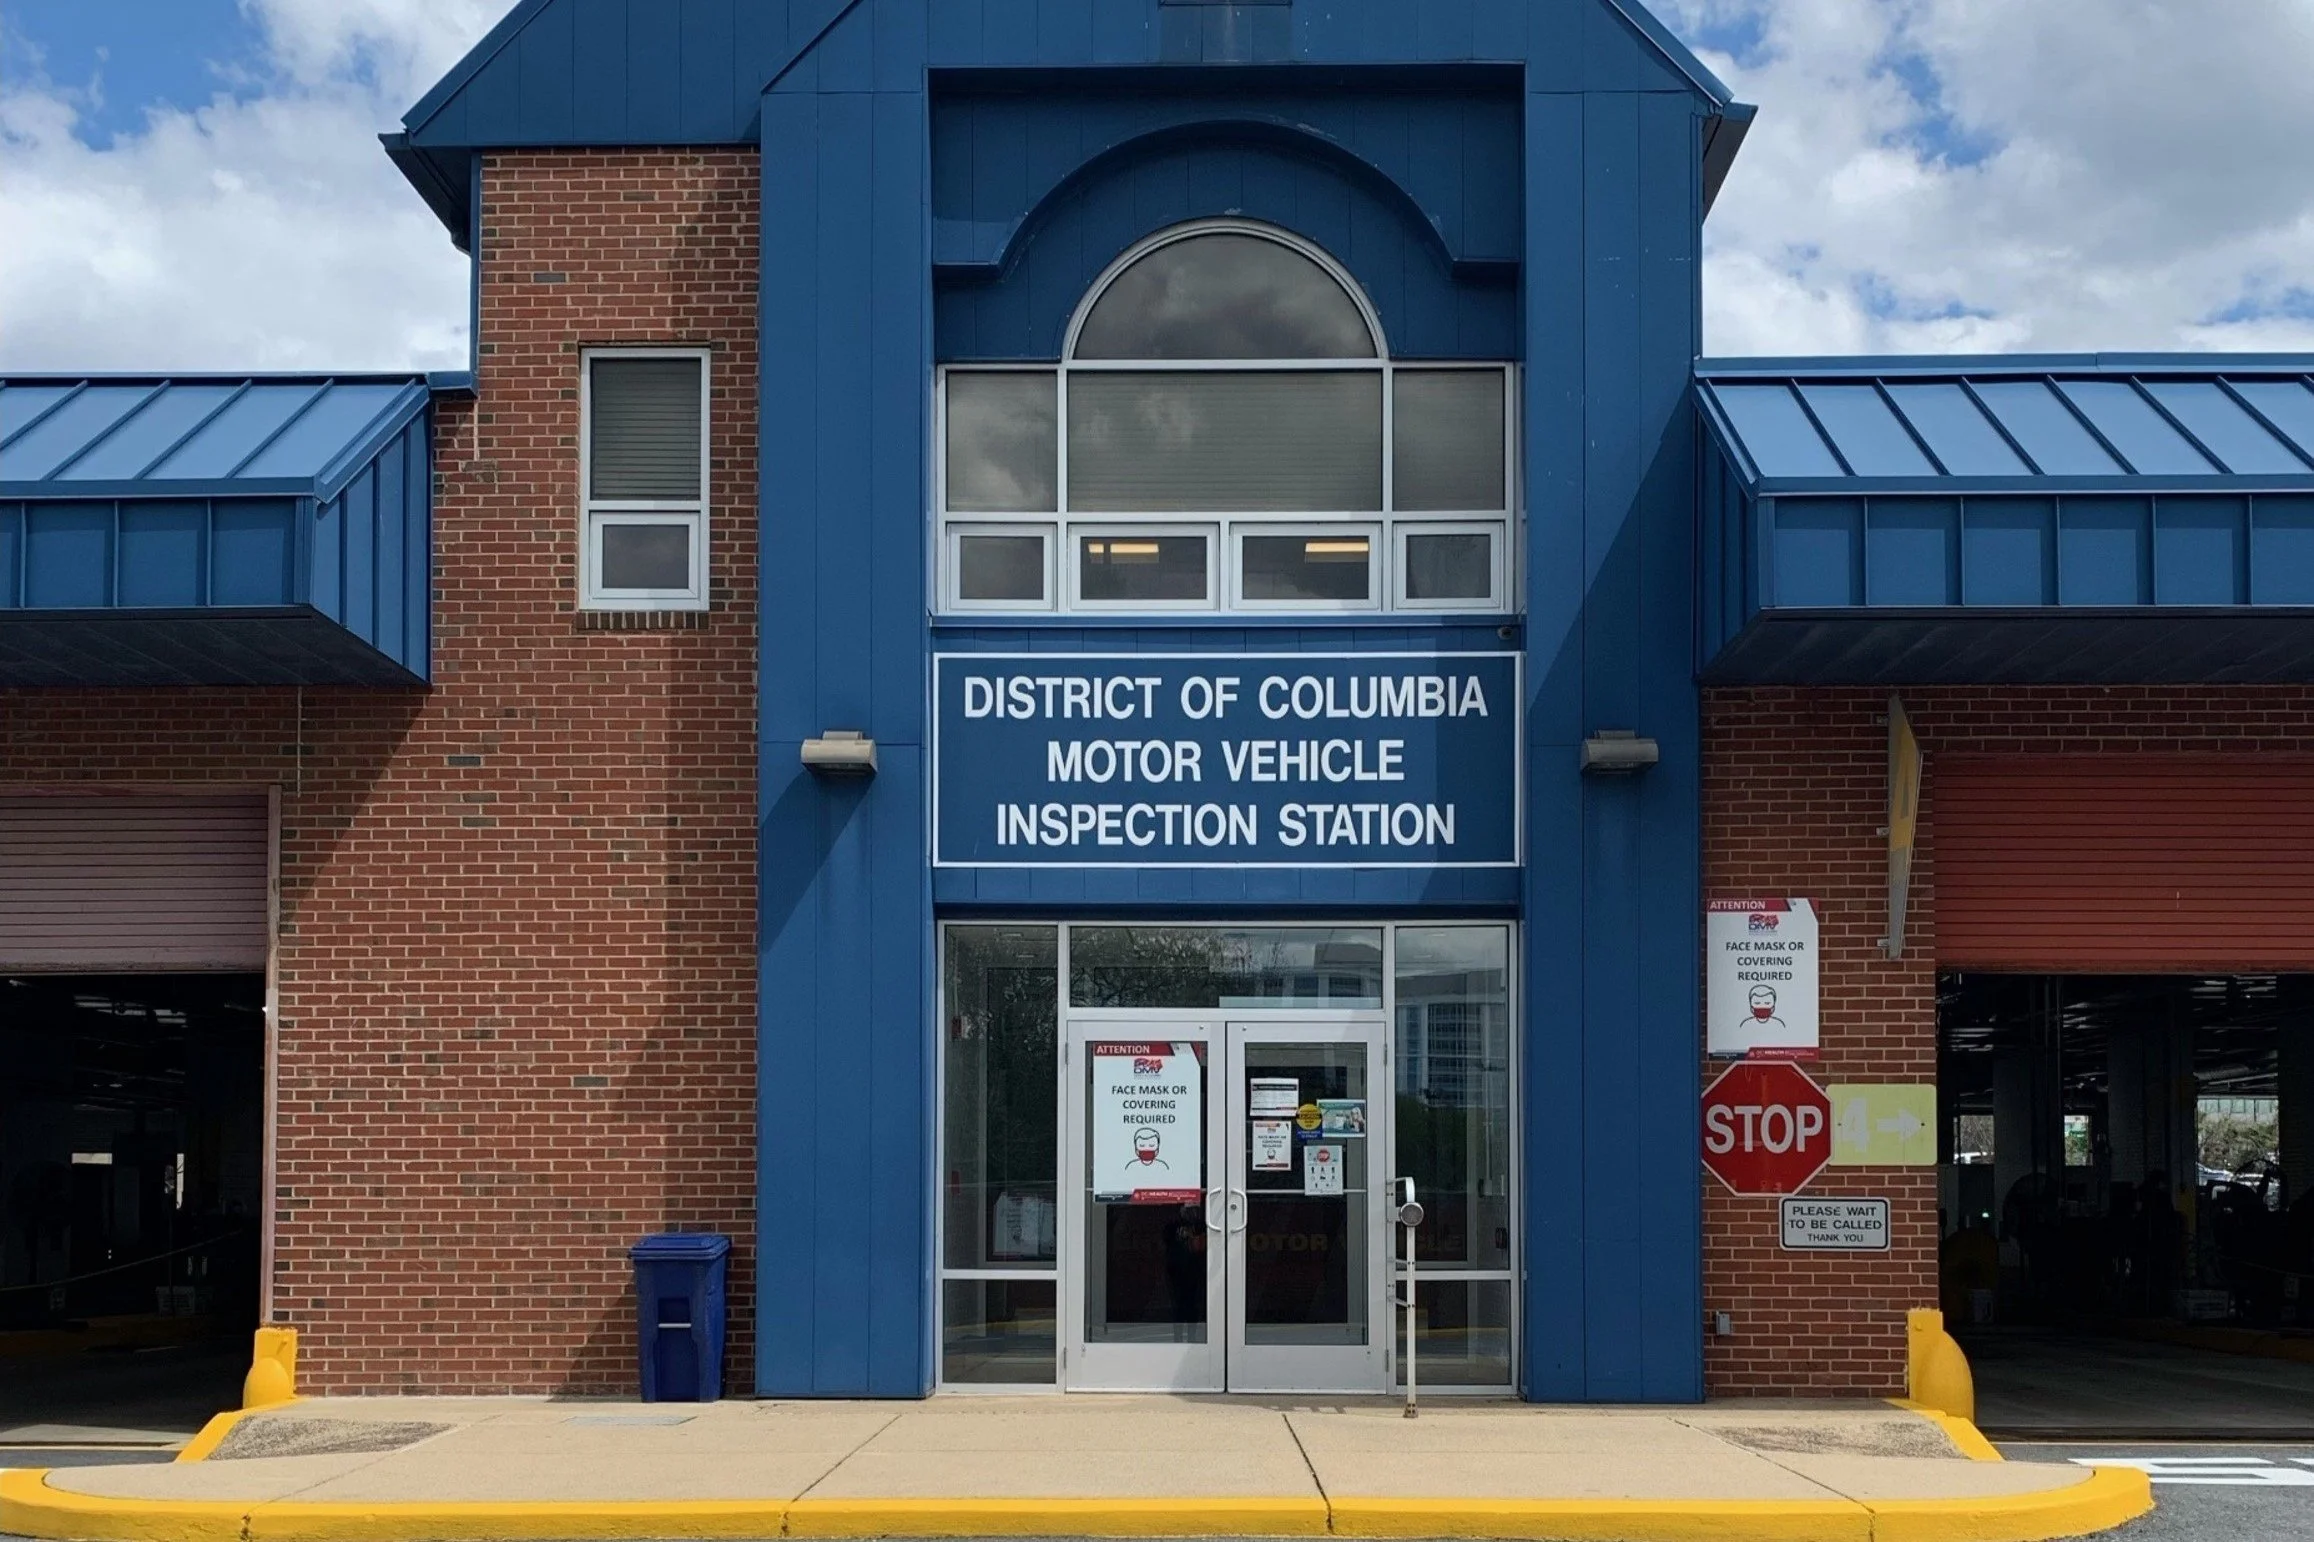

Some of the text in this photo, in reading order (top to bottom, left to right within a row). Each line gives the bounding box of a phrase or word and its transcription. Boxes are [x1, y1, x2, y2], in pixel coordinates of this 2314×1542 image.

[964, 675, 1489, 720] DISTRICT OF COLUMBIA
[1047, 739, 1405, 783] MOTOR VEHICLE
[997, 802, 1456, 847] INSPECTION STATION
[1709, 900, 1766, 911] ATTENTION
[1725, 941, 1805, 951] FACE MASK OR
[1736, 956, 1793, 966] COVERING
[1737, 971, 1793, 982] REQUIRED
[1096, 1045, 1151, 1054] ATTENTION
[1111, 1085, 1187, 1095] FACE MASK OR
[1122, 1100, 1176, 1110] COVERING
[1123, 1114, 1176, 1125] REQUIRED
[1705, 1103, 1824, 1154] STOP
[1792, 1206, 1877, 1217] PLEASE WAIT
[1788, 1219, 1882, 1230] TO BE CALLED
[1807, 1233, 1864, 1243] THANK YOU
